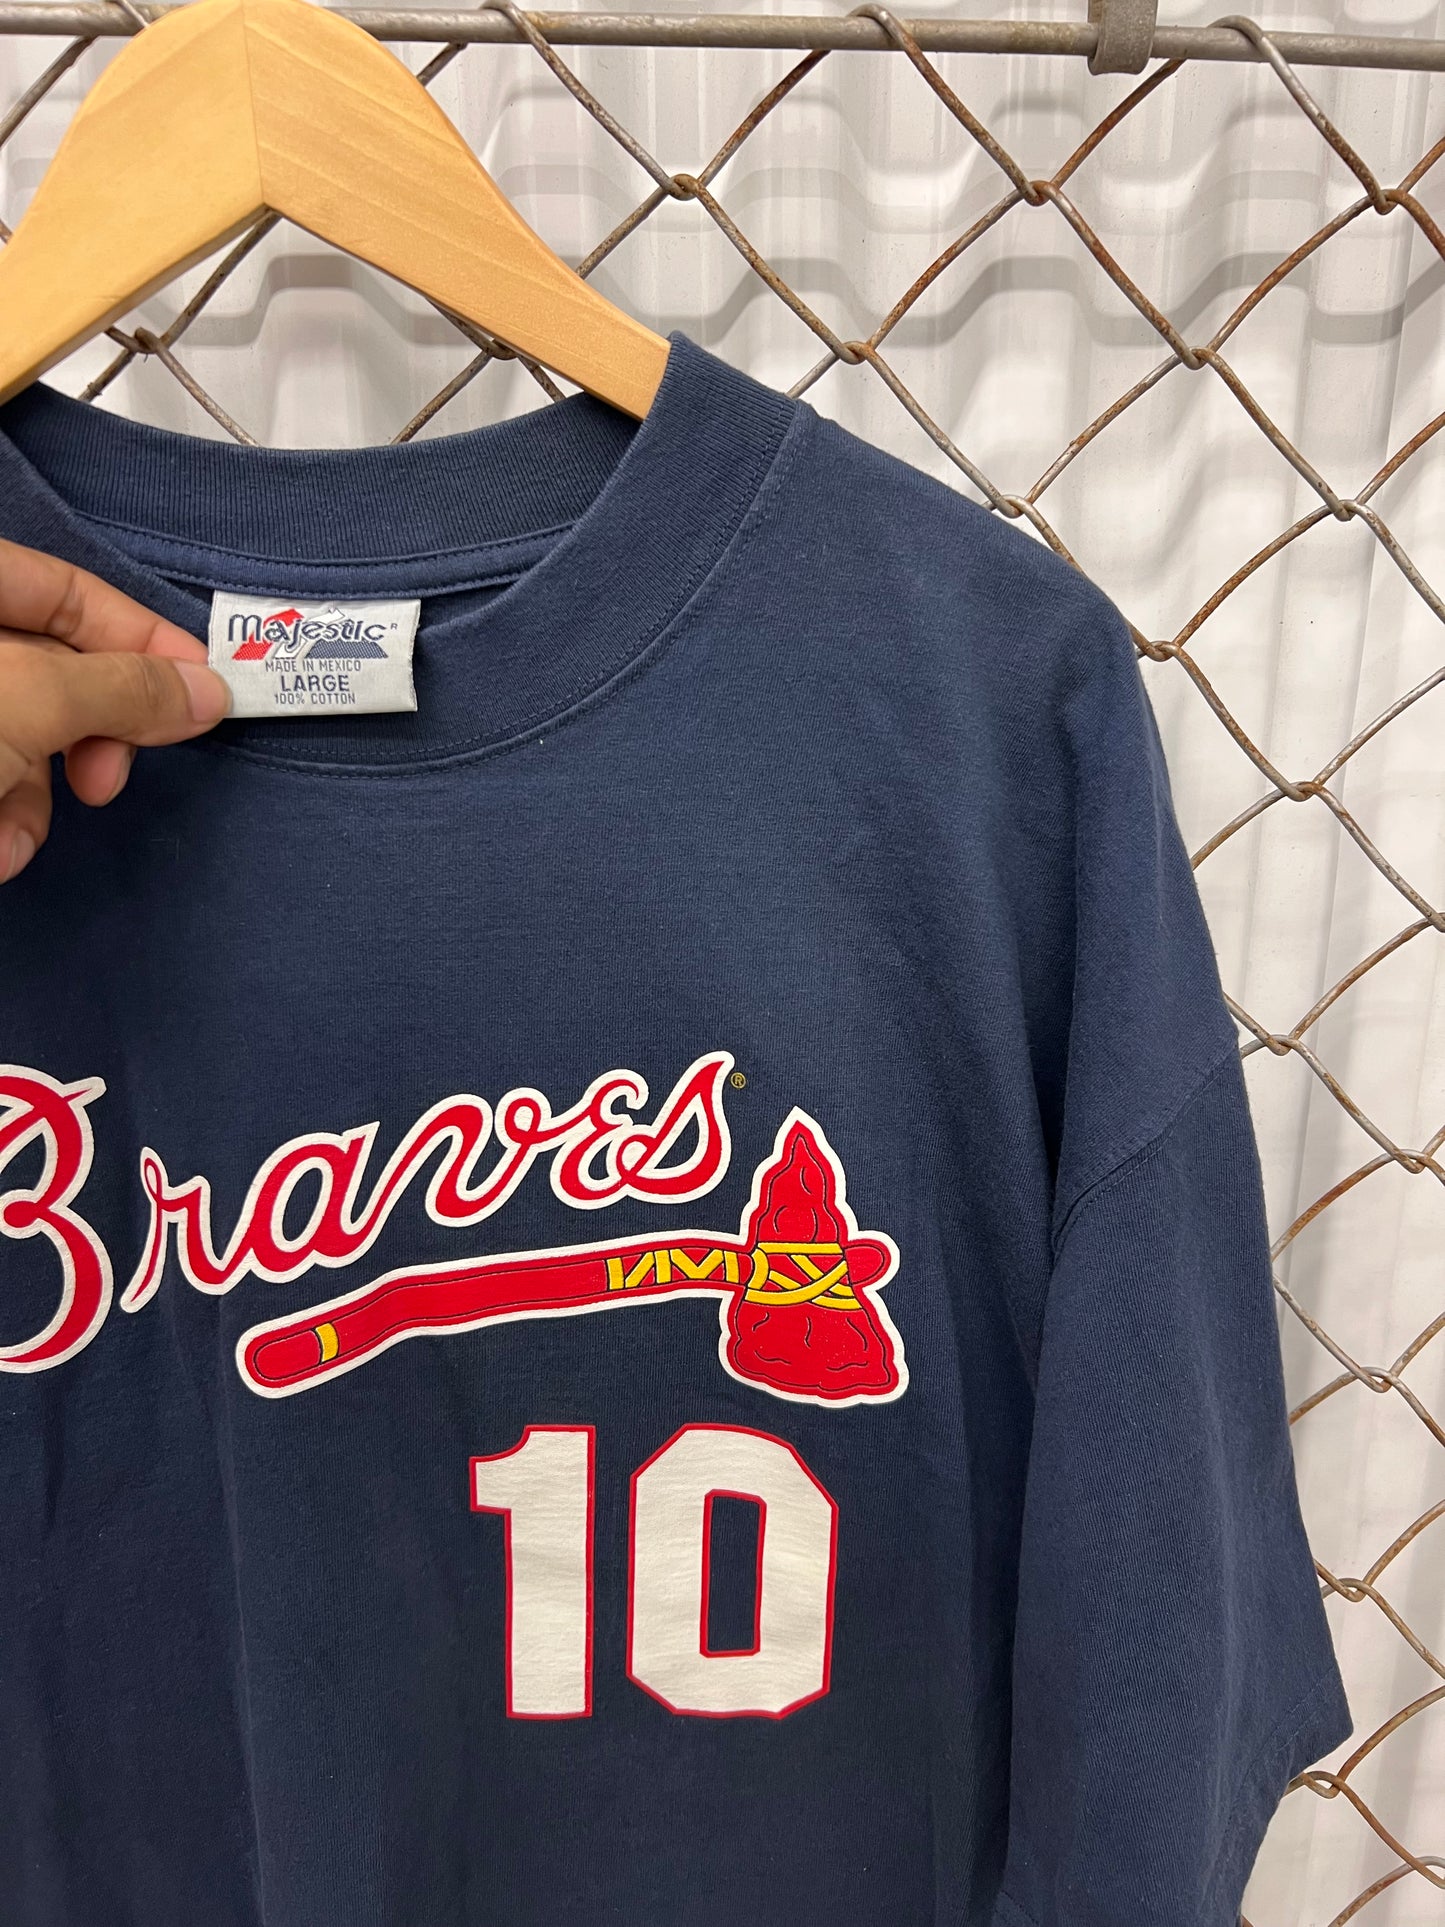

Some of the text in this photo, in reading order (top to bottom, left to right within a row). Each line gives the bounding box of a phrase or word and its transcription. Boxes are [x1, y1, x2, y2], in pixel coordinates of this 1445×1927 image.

[265, 660, 361, 672] MADE IN MEXICO
[281, 674, 350, 691] LARGE
[274, 692, 356, 704] 100% COTTON
[470, 1423, 840, 1721] 10
